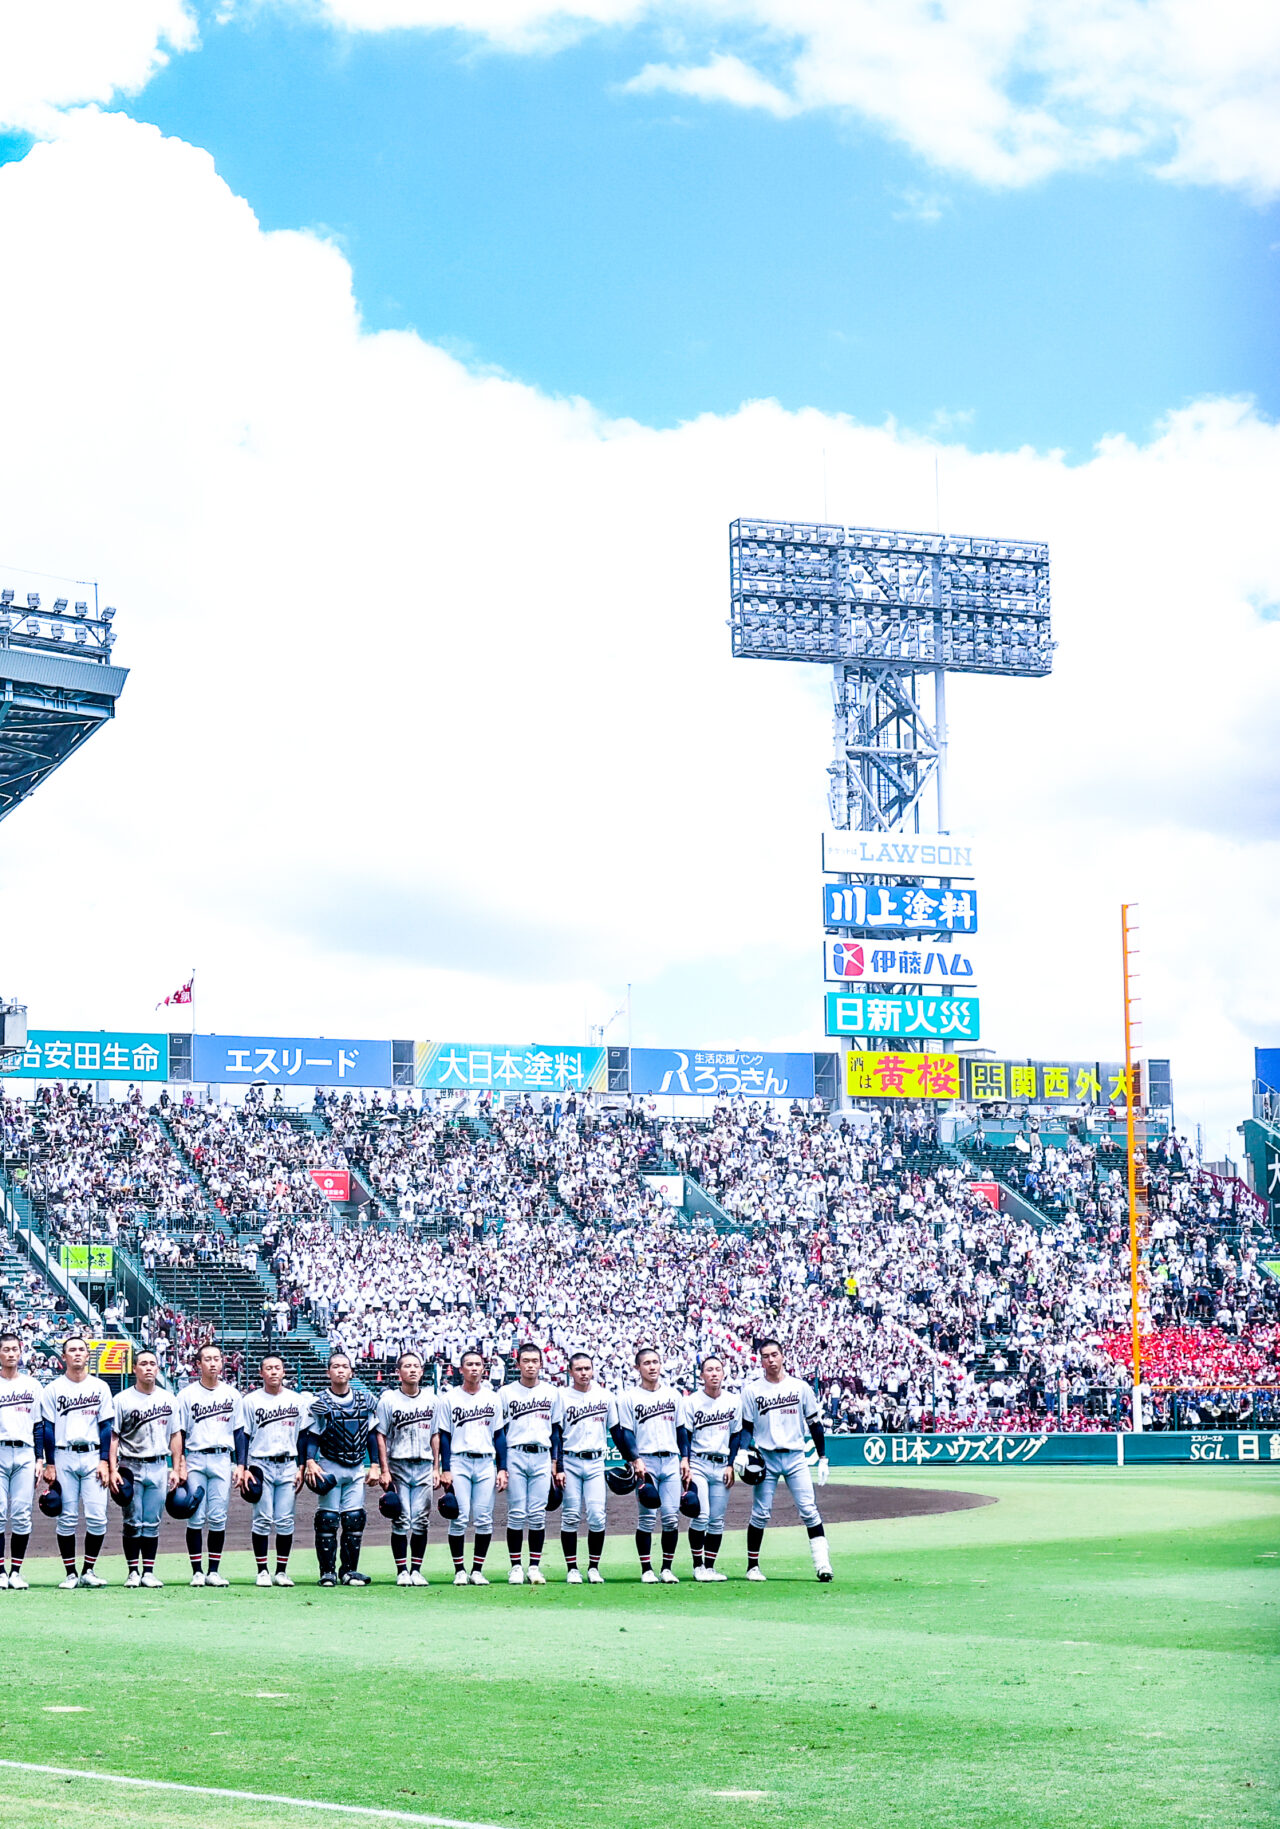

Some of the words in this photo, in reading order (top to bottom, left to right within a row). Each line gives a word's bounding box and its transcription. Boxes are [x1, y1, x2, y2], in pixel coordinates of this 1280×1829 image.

[860, 842, 972, 866] LAWSON
[831, 887, 975, 929] 川上塗料
[871, 950, 973, 976] 伊藤ハム
[836, 998, 971, 1034] 日新火災
[225, 1047, 360, 1078] エスリード
[438, 1050, 584, 1088] 大日本塗料
[694, 1053, 764, 1066] 生活応援バンク
[694, 1066, 789, 1095] ろうきん
[873, 1055, 957, 1095] 黄桜
[57, 1392, 101, 1412] Risshodai
[755, 1391, 800, 1412] Risshodai
[892, 1435, 1049, 1464] 日本ハウズイング
